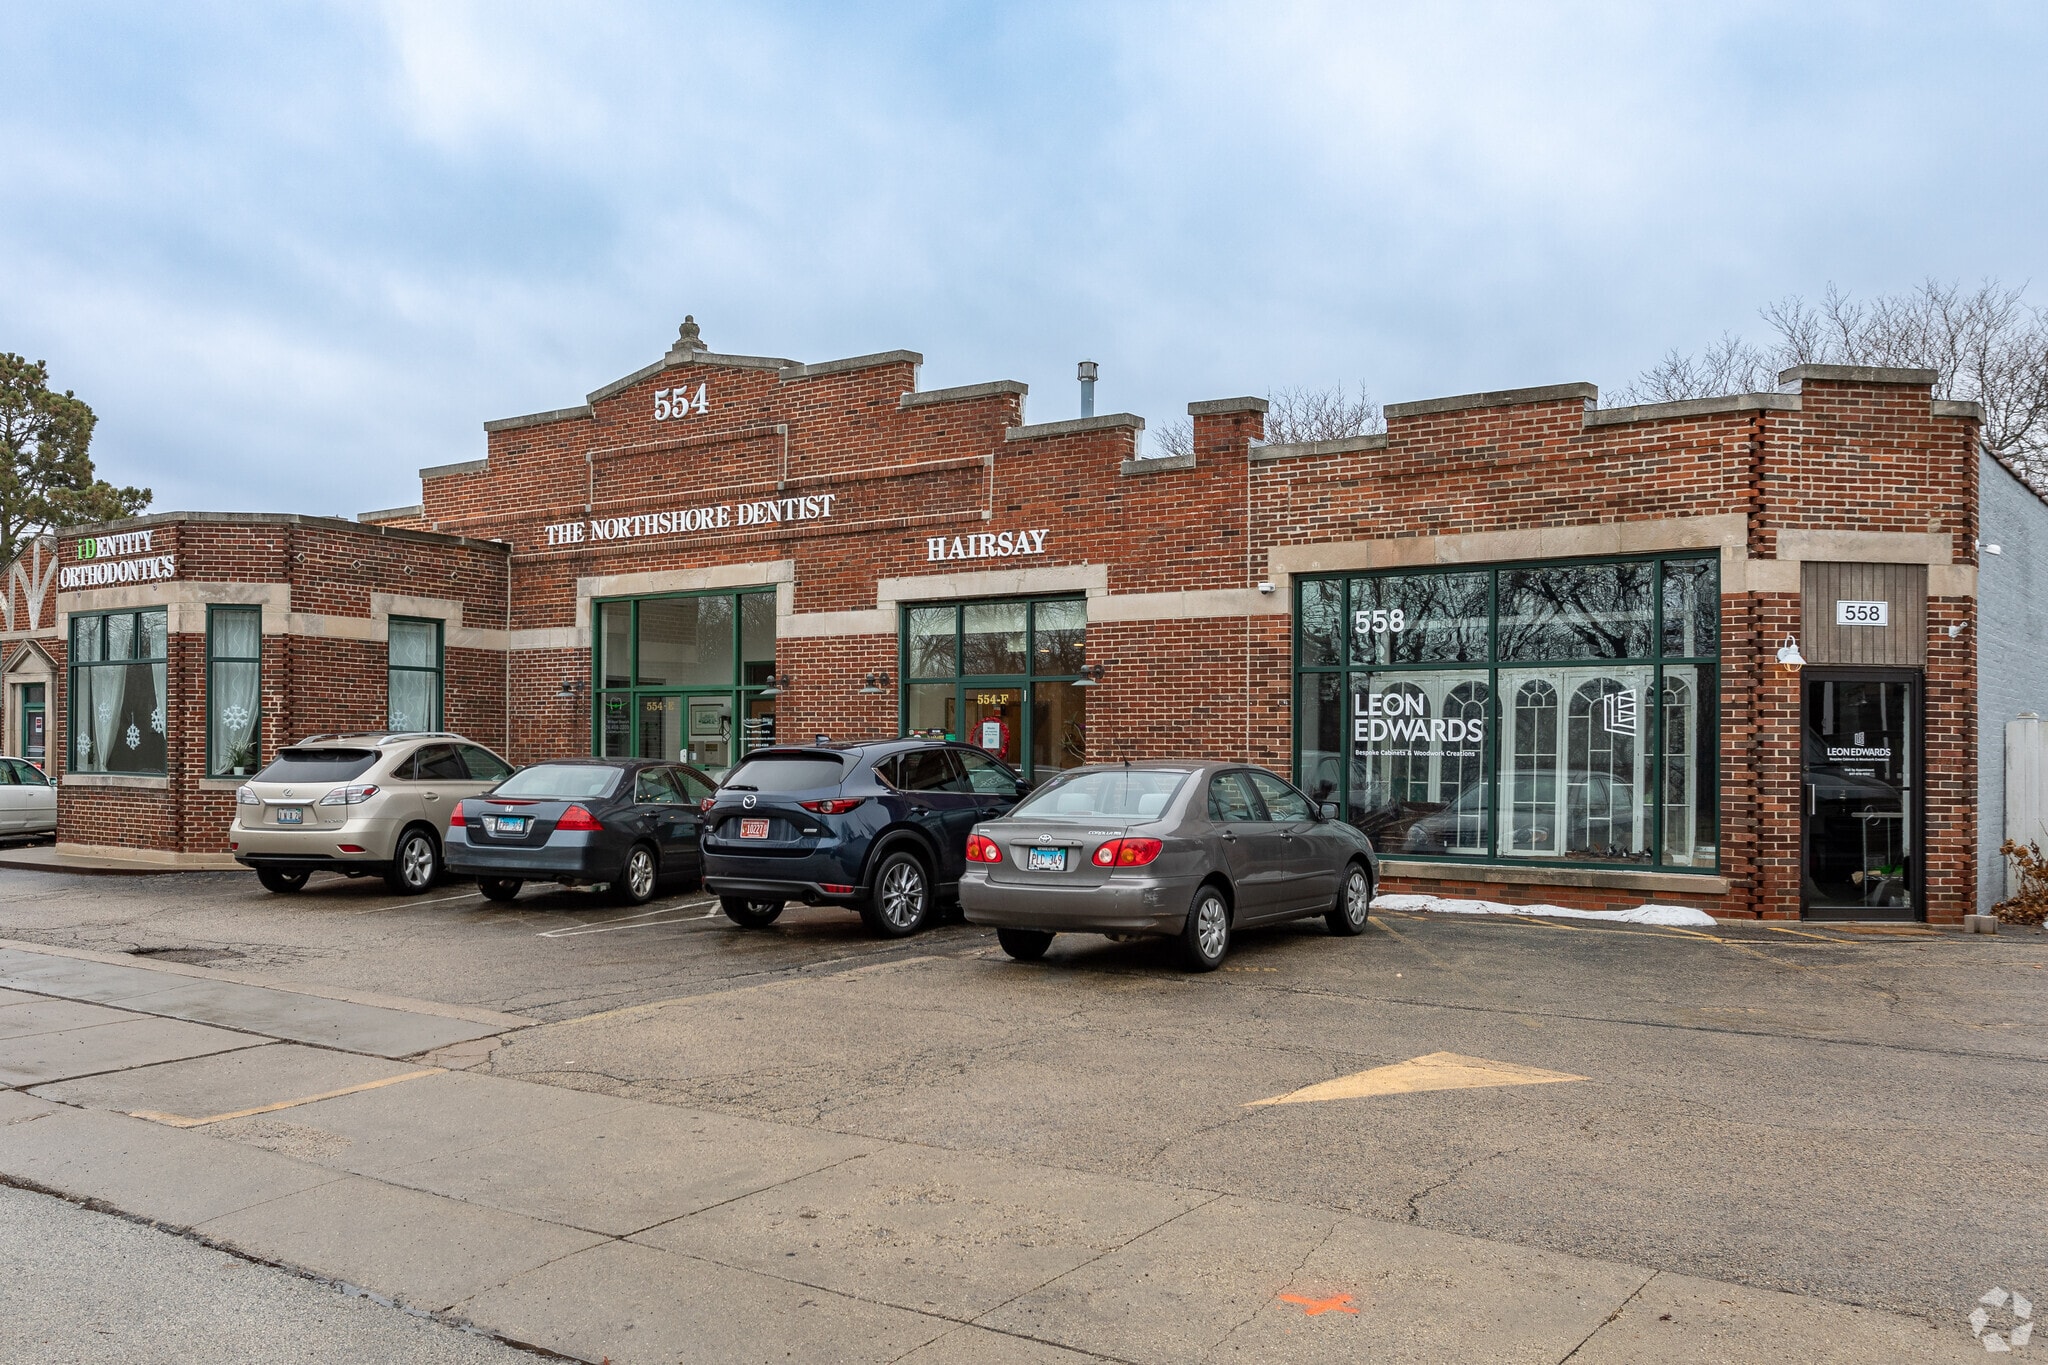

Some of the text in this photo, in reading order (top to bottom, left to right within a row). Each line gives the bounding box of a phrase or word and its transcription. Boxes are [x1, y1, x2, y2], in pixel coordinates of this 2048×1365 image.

[655, 383, 709, 420] 554
[545, 494, 835, 545] THE NORTHSHORE DENTIST
[927, 529, 1050, 561] HAIRSAY
[60, 555, 175, 588] ORTHODONTICS
[1354, 609, 1405, 633] 558
[1845, 606, 1880, 621] 558
[977, 694, 1009, 705] 554-F
[1355, 693, 1424, 716] LEON
[1355, 719, 1483, 742] EDWARDS
[1827, 747, 1891, 757] LEON EDWARDS
[1031, 853, 1063, 866] PLC 349
